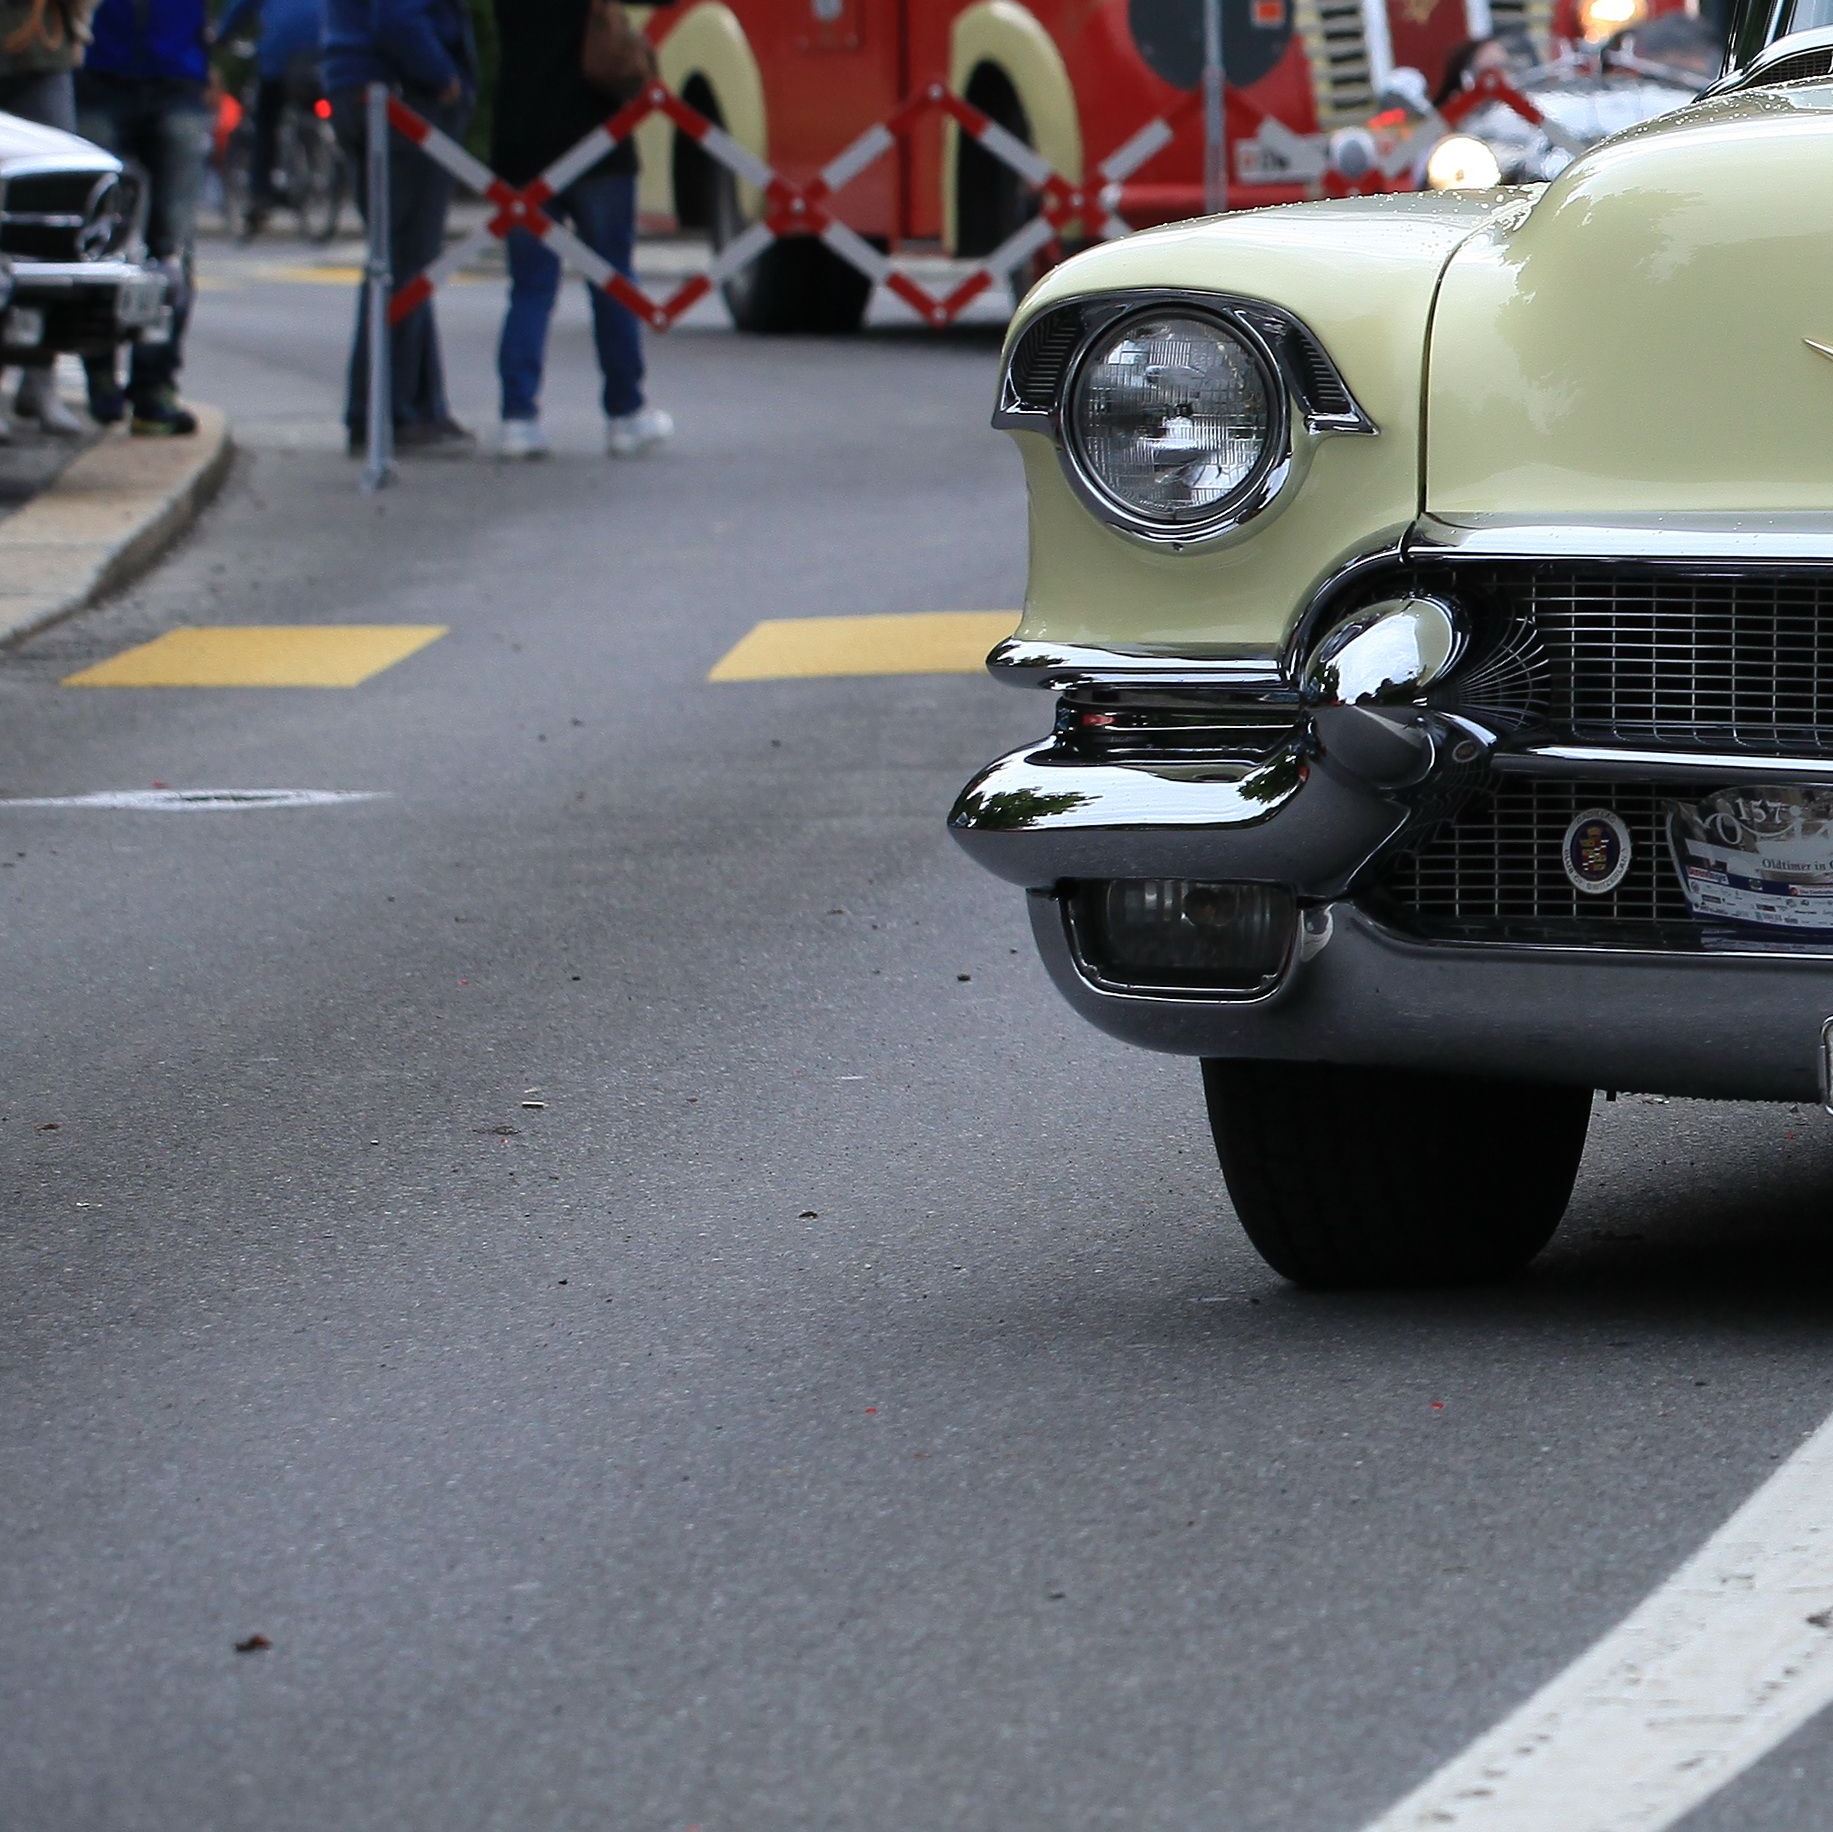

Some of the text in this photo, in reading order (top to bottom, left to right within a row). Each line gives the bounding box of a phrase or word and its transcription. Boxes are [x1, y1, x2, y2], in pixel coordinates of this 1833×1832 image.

[1734, 797, 1788, 825] 157
[1761, 857, 1810, 871] Oldtimer
[1814, 859, 1827, 871] in
